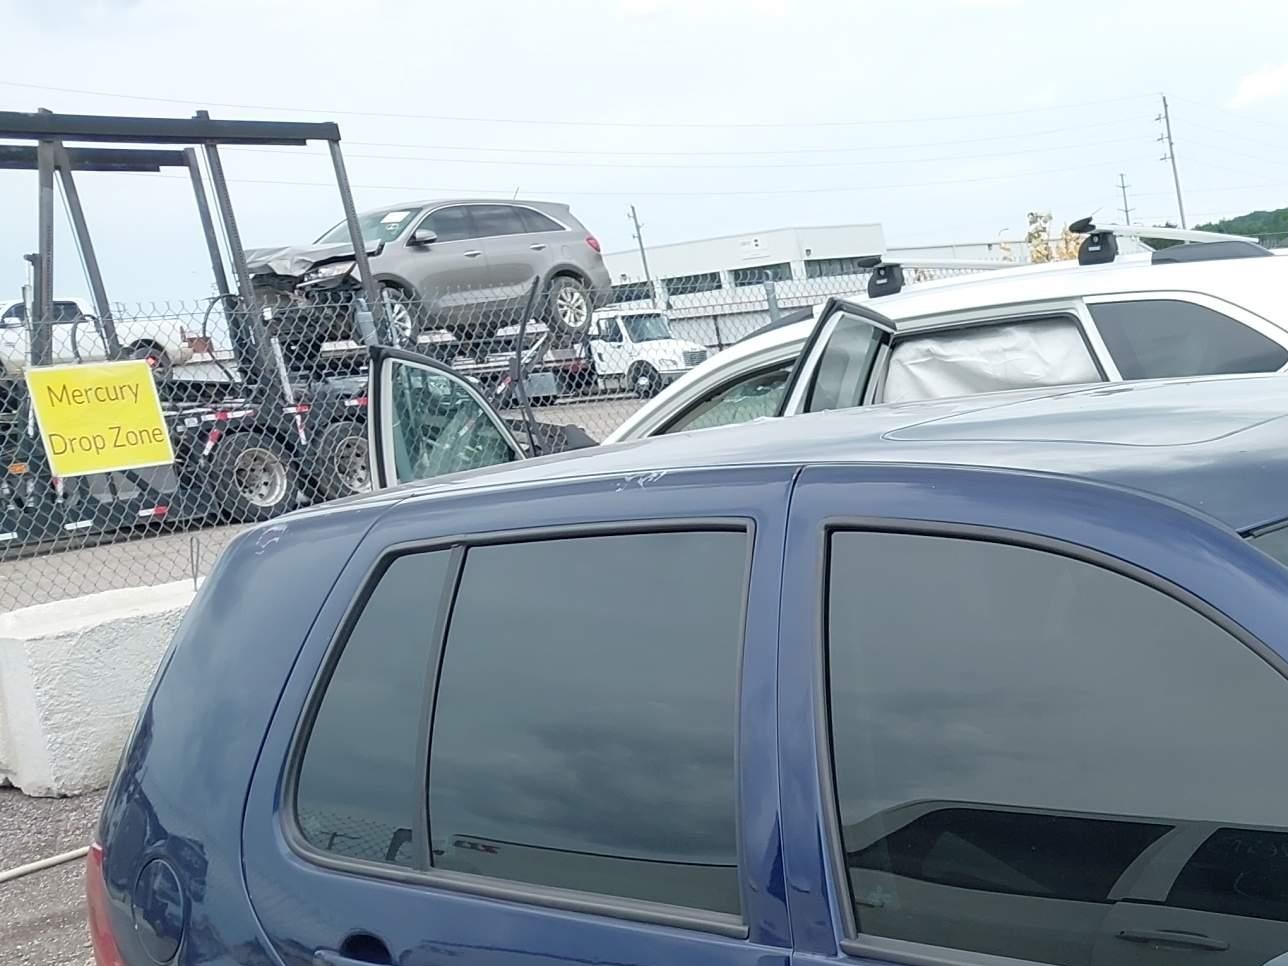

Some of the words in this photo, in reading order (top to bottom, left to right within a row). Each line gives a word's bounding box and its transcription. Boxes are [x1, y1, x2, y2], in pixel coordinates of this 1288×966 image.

[46, 383, 139, 407] Mercury
[48, 433, 106, 455] Drop
[108, 426, 165, 448] Zone
